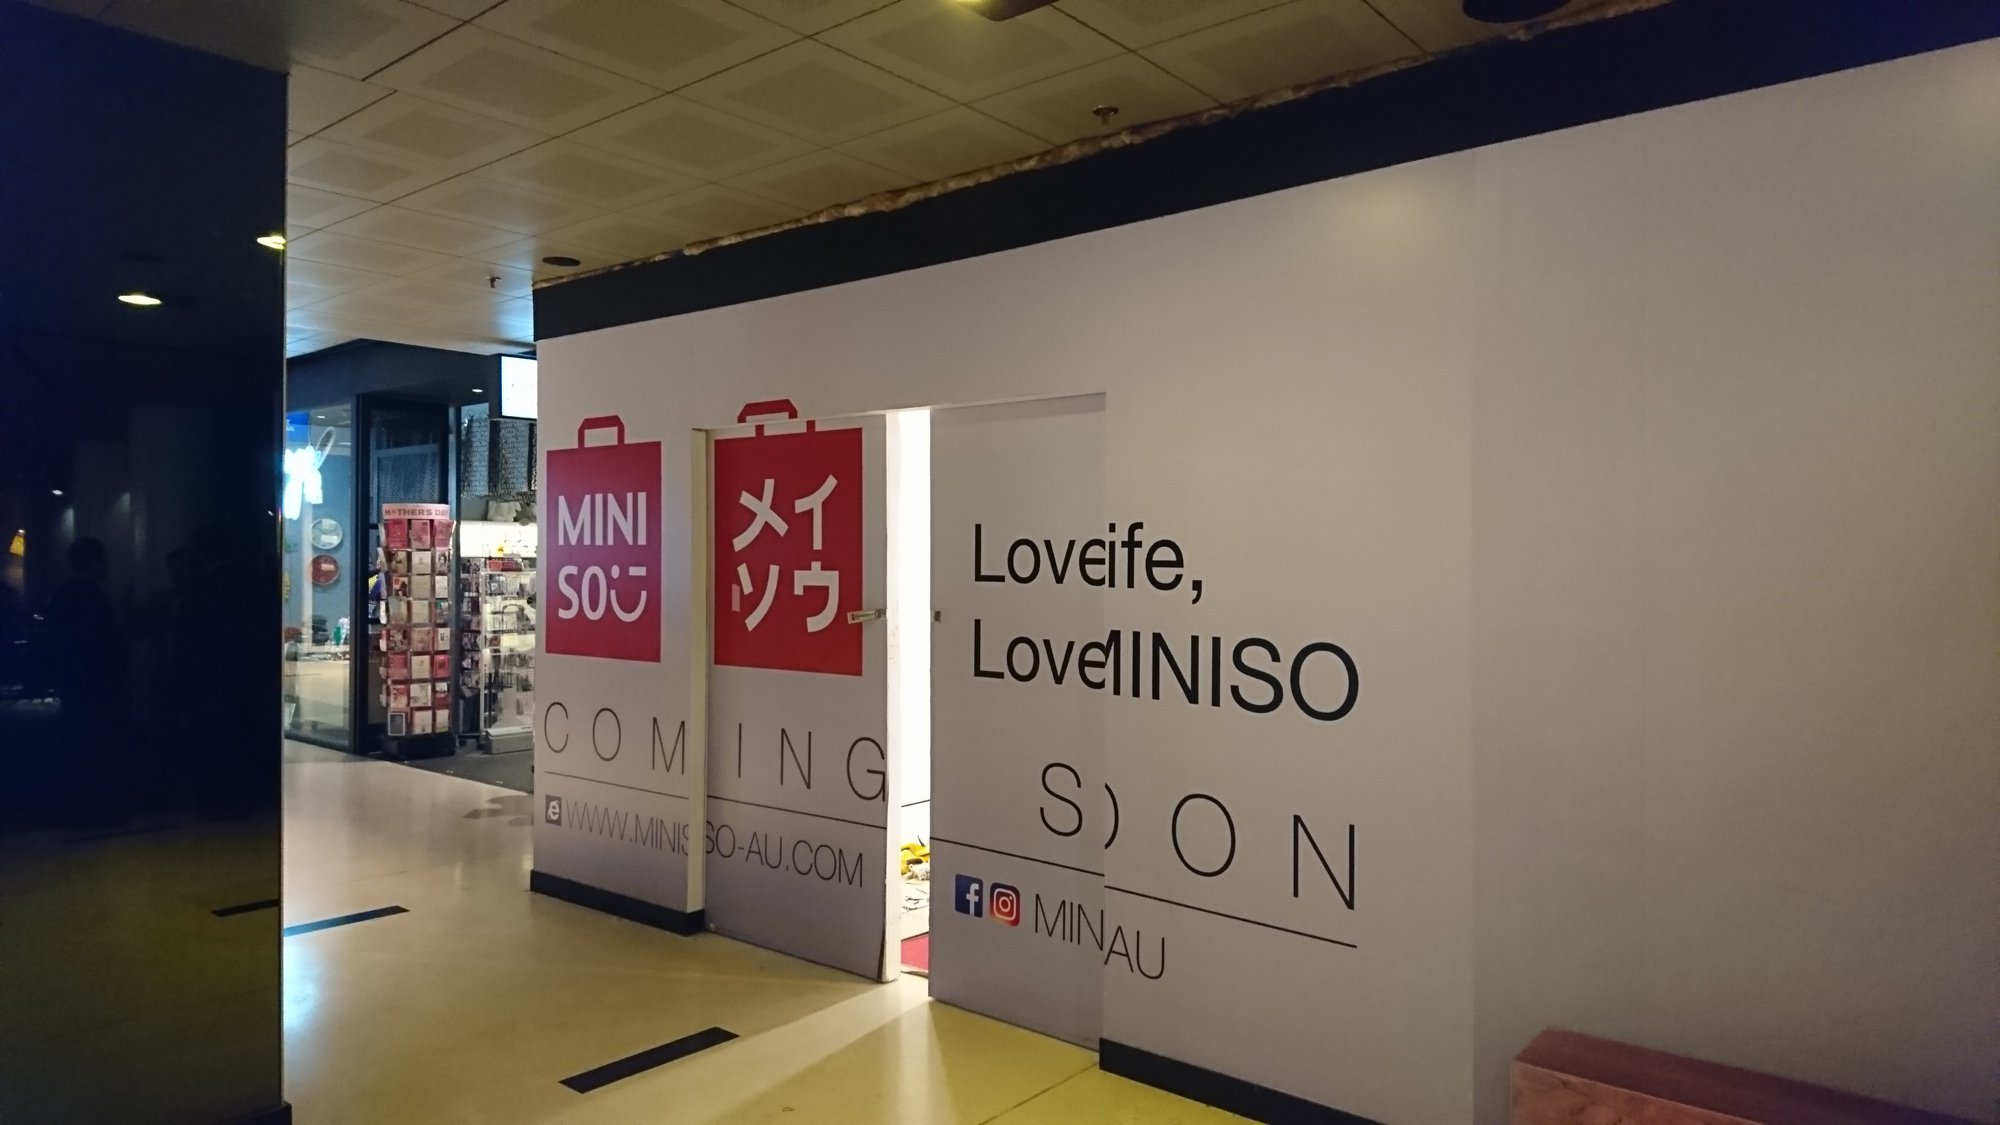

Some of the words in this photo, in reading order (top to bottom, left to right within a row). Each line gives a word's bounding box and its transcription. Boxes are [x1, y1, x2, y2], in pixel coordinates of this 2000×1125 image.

[384, 508, 433, 516] MTHERS
[435, 509, 449, 517] DAY
[557, 491, 647, 546] MINI
[732, 474, 838, 552] メイ
[736, 561, 840, 633] ソウ
[1107, 521, 1203, 605] ife,
[544, 701, 886, 803] COMING
